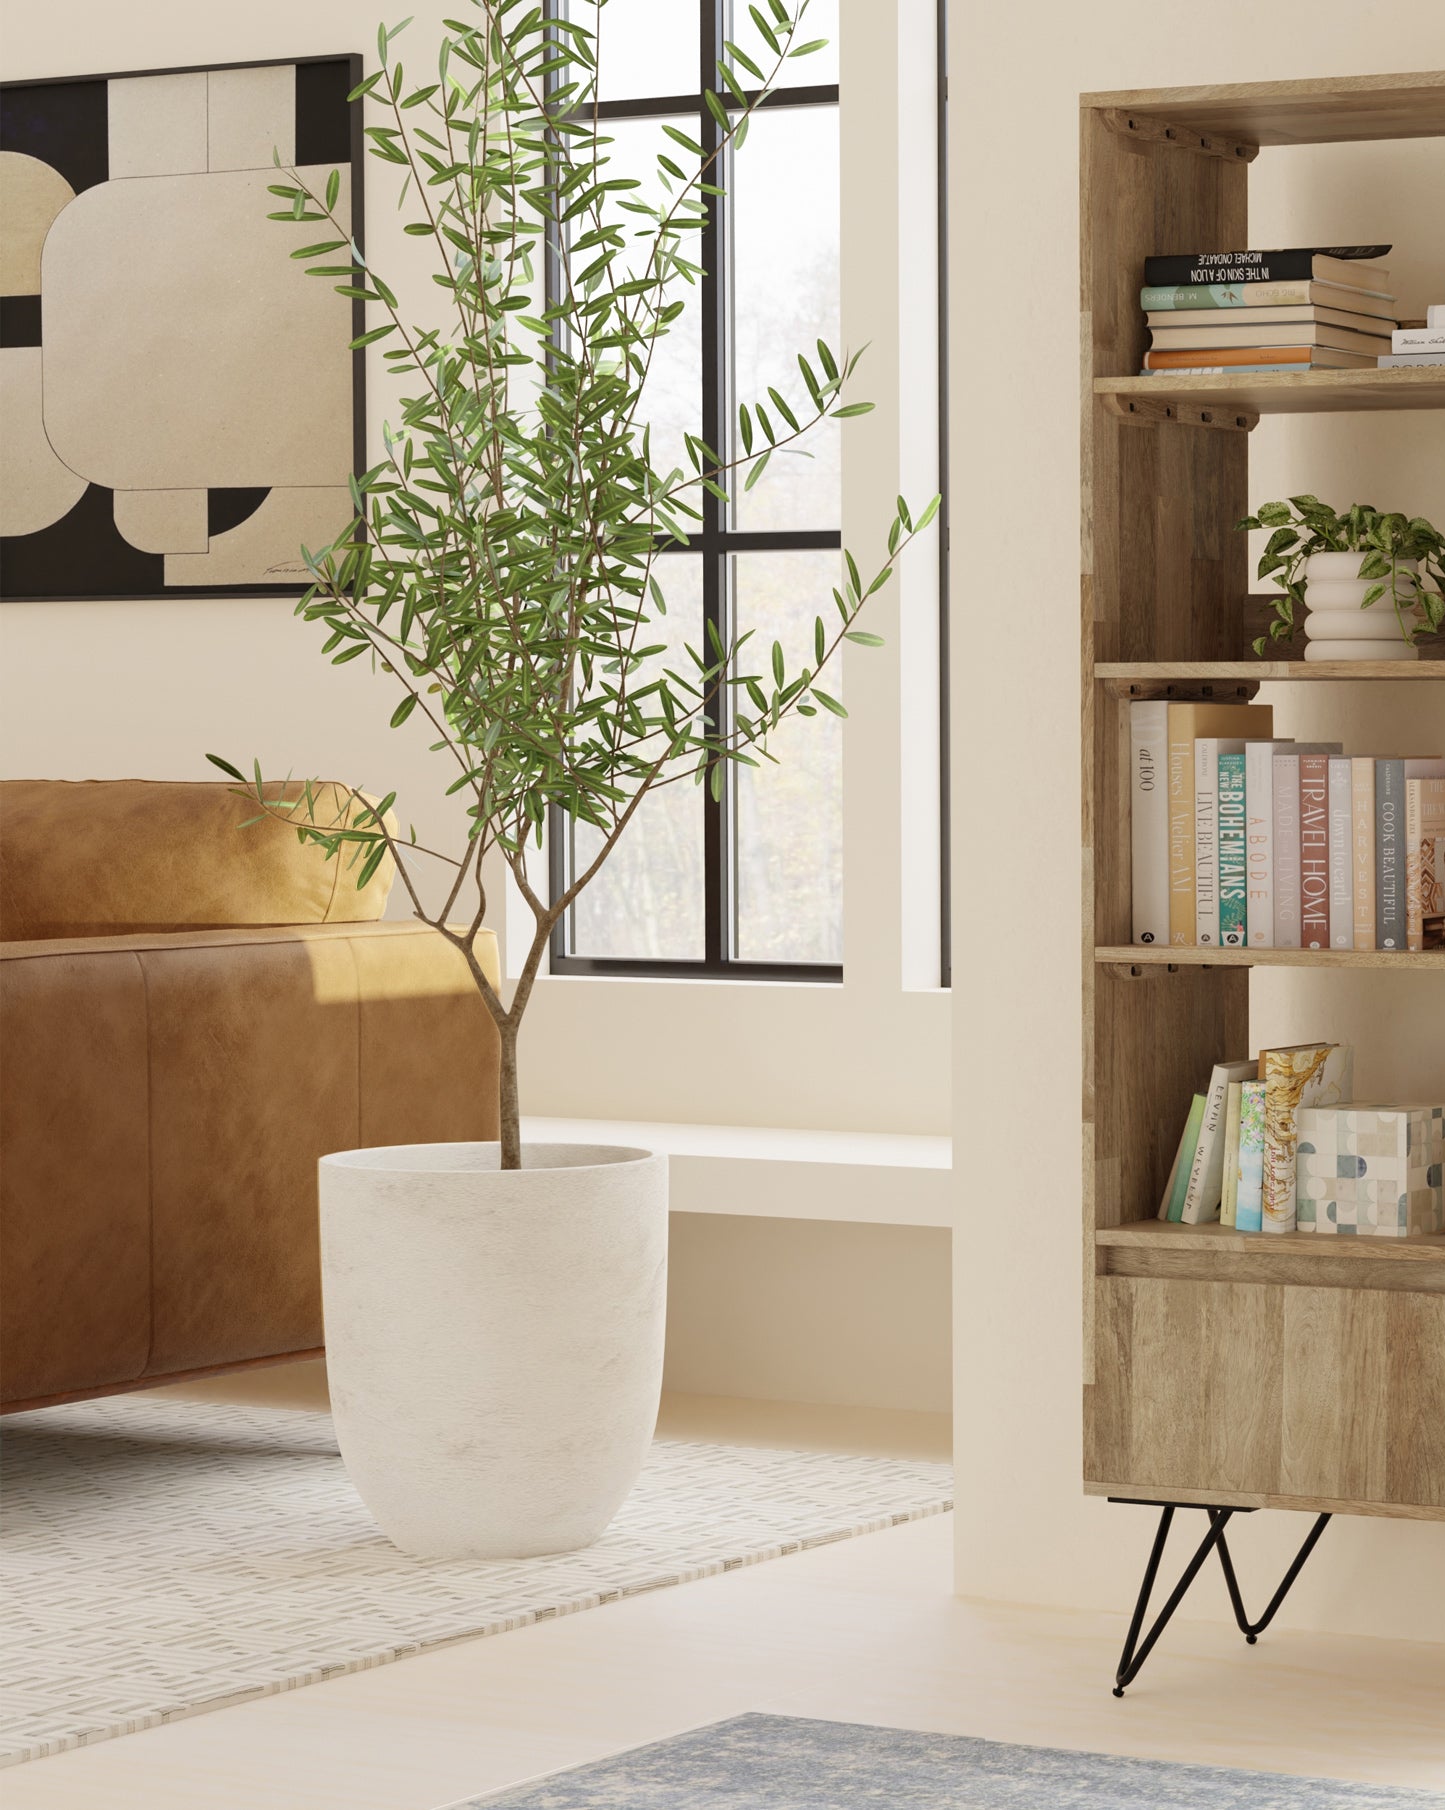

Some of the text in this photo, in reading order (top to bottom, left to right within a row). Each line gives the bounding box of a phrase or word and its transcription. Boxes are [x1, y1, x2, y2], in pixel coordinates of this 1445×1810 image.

[1190, 270, 1209, 282] LION
[1198, 252, 1263, 266] MICHAEL ONDAATJE
[1216, 269, 1228, 282] OF
[1227, 268, 1245, 281] SKIN
[1246, 268, 1262, 281] THE
[1261, 267, 1270, 280] IN
[1140, 748, 1155, 791] at 100
[1219, 772, 1230, 791] NEW
[1231, 773, 1243, 788] THE
[1171, 743, 1192, 892] Houses Atelier AM
[1278, 785, 1293, 838] MADE
[1198, 792, 1214, 920] LIVE BEAUTIFUL
[1219, 792, 1246, 899] BOHEMIANS
[1250, 817, 1268, 898] ABODE
[1302, 774, 1327, 931] TRAVEL HOME
[1333, 809, 1351, 905] down to earth
[1357, 800, 1368, 917] HARVEST
[1382, 802, 1396, 925] COOK BEAUTIFUL
[1280, 857, 1295, 921] LIVING
